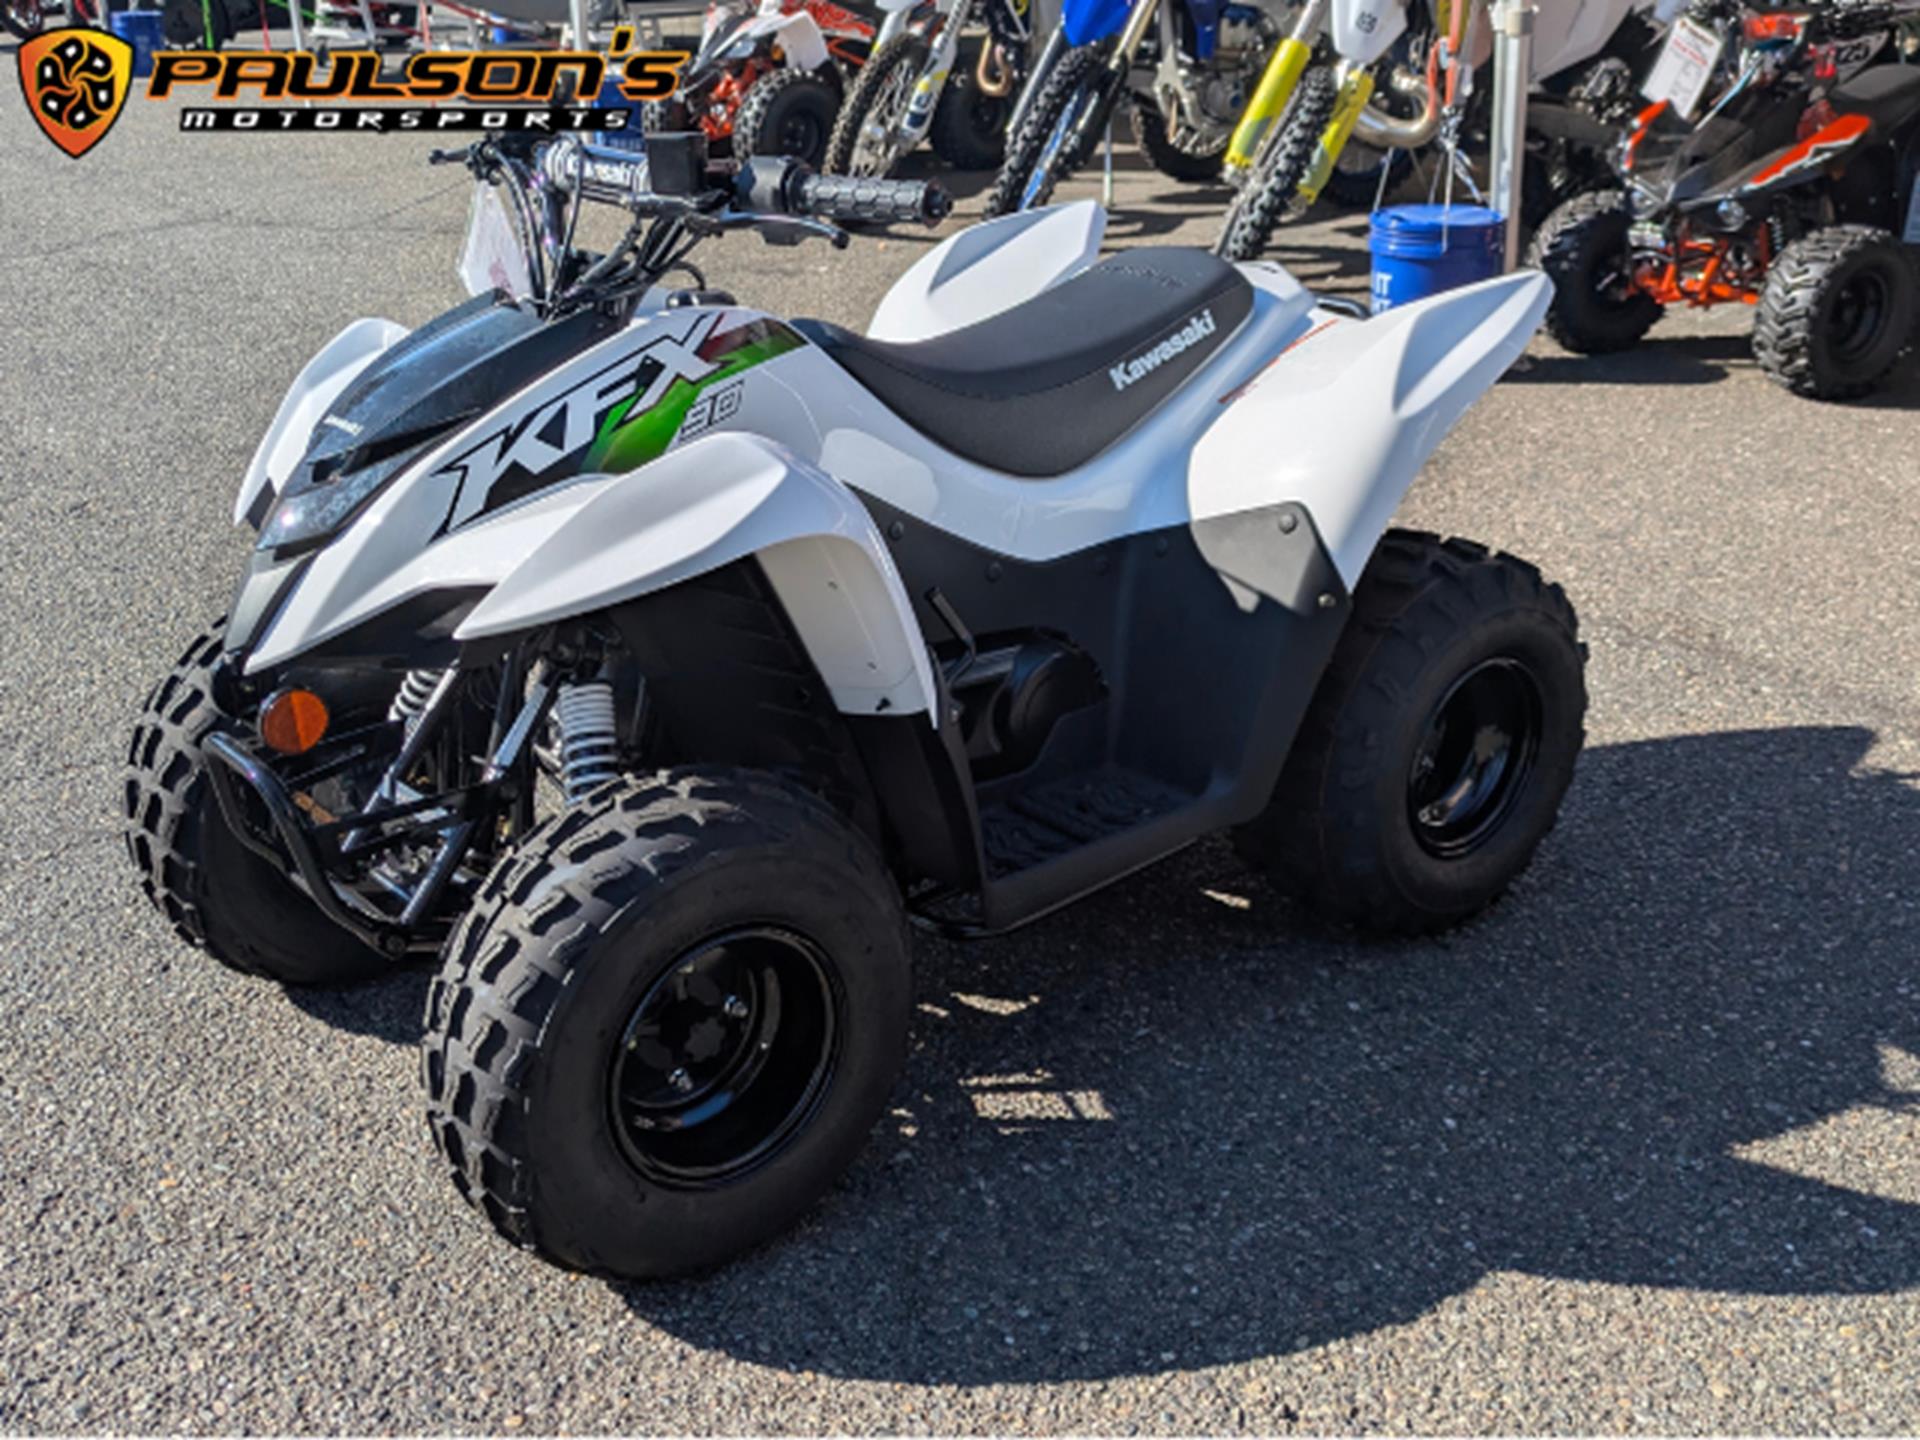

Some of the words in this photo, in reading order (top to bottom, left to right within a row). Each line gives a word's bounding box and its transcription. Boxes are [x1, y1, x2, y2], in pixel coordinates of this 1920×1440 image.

[1108, 309, 1217, 391] Kawasaki
[428, 312, 734, 544] KFX
[678, 379, 745, 441] 90
